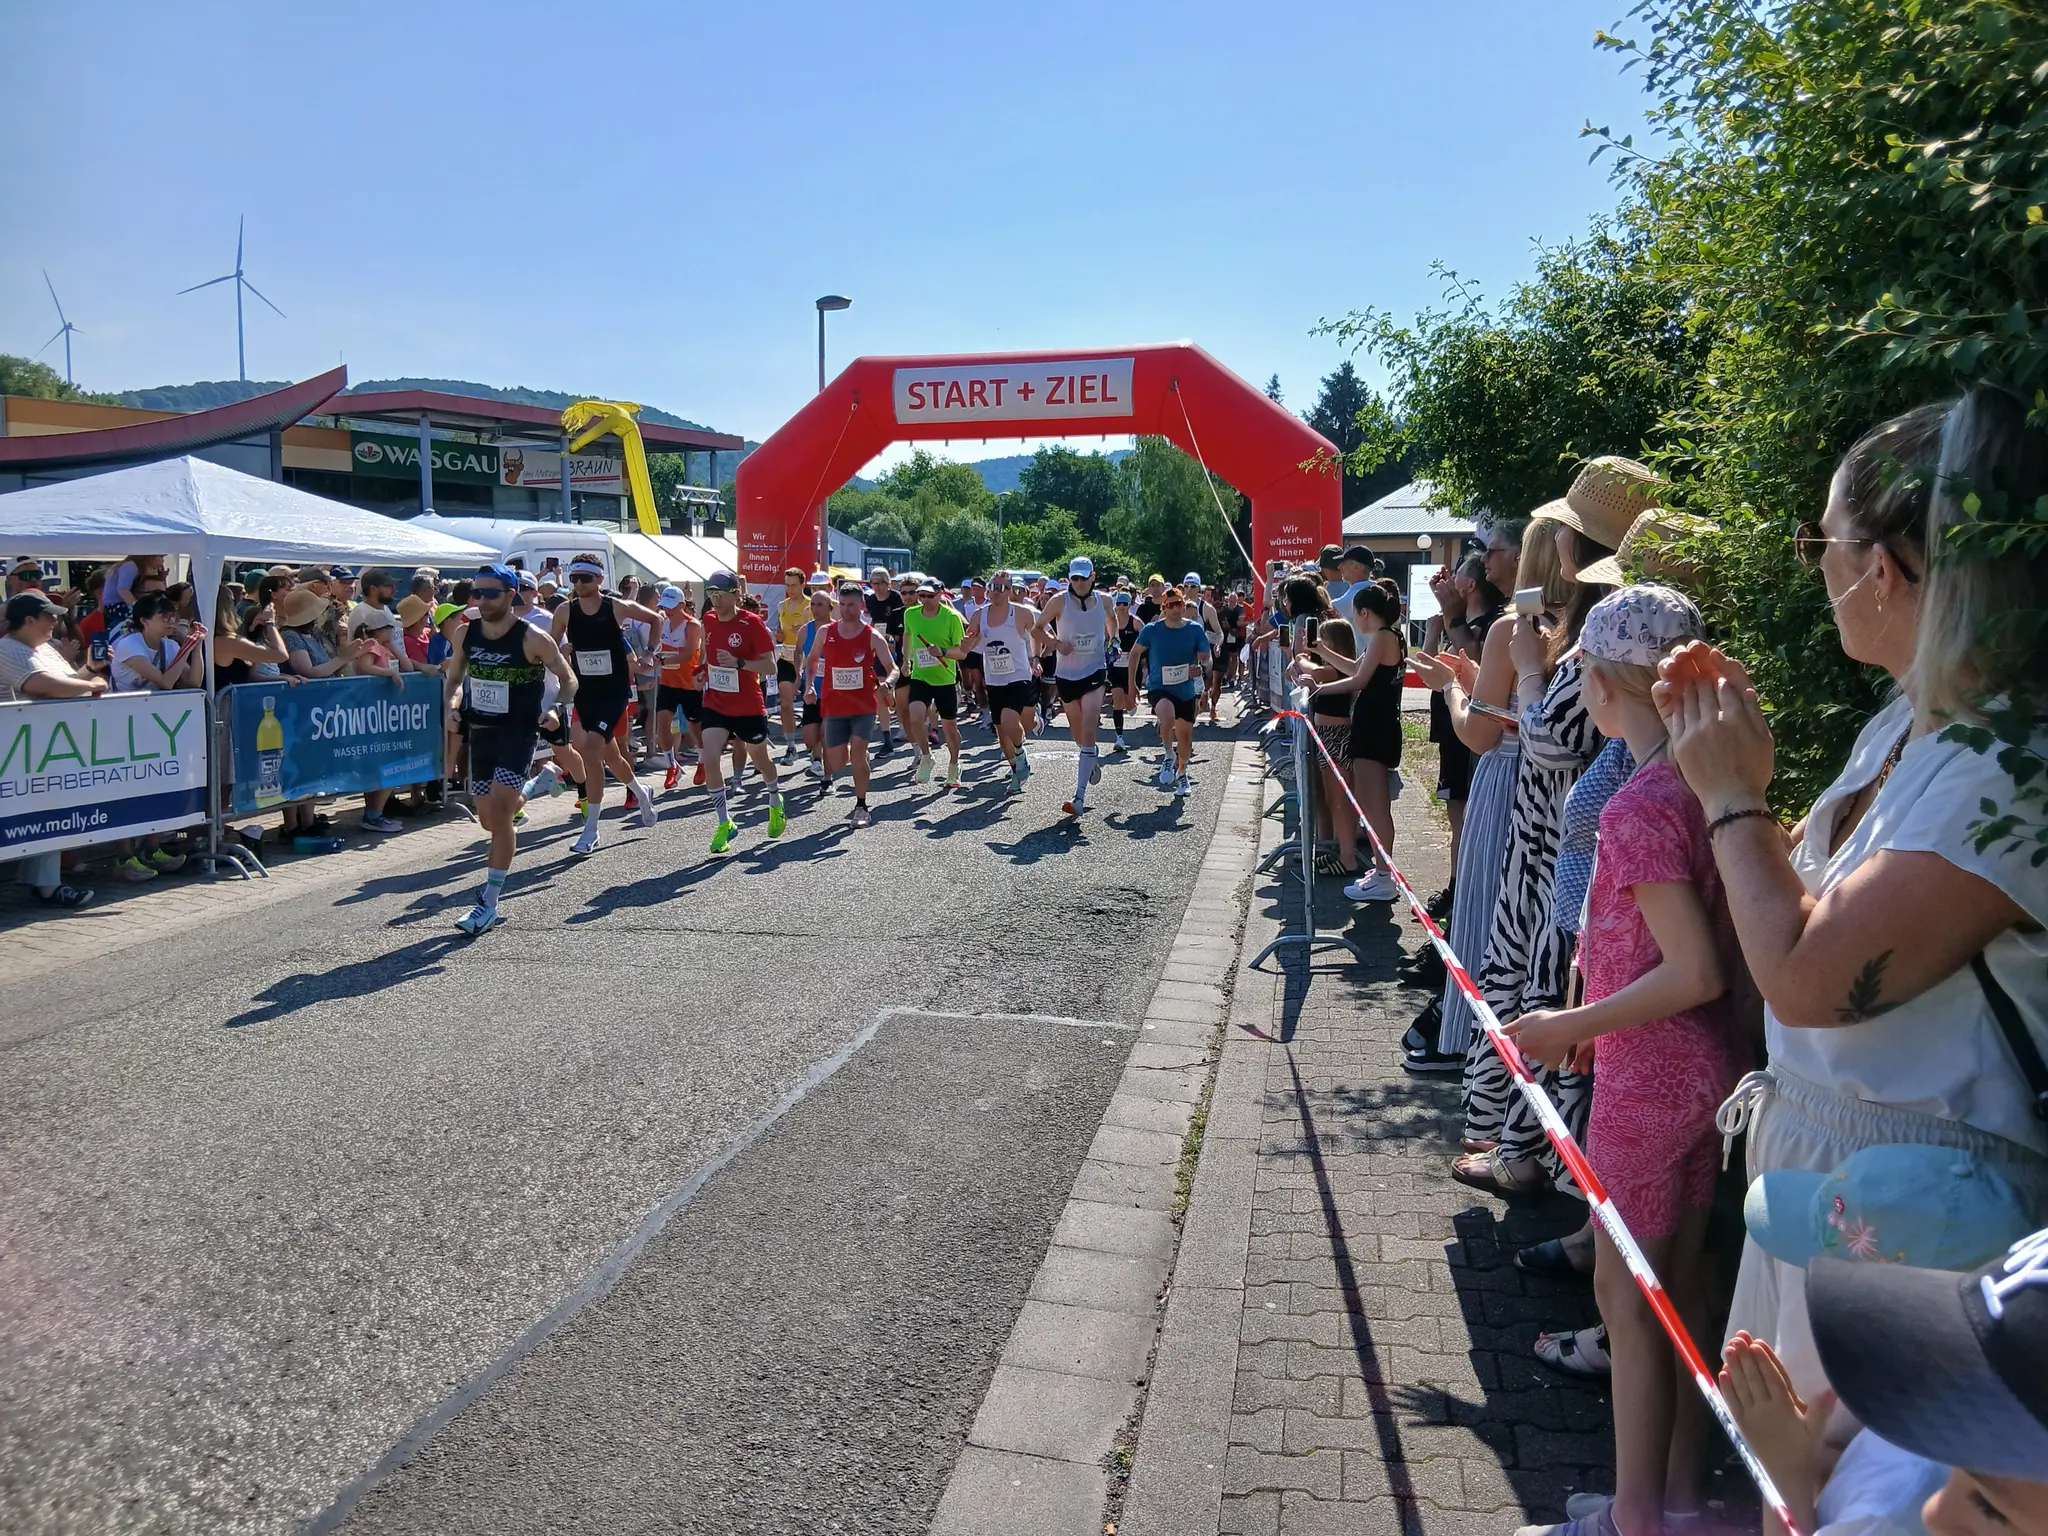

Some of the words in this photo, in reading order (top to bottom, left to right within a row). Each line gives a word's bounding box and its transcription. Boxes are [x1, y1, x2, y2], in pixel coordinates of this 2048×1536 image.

[908, 379, 1009, 410] START
[1016, 381, 1036, 401] +
[1046, 374, 1118, 405] ZIEL
[383, 445, 497, 474] WASGAU
[1282, 525, 1299, 534] Wir
[752, 532, 766, 540] Wir
[1269, 535, 1313, 546] wünschen
[749, 553, 770, 561] Ihnen
[1278, 548, 1304, 557] Ihnen
[742, 562, 753, 571] viel
[754, 563, 780, 573] Erfolg!
[585, 658, 603, 666] 1341
[713, 673, 731, 682] 1018
[476, 689, 496, 699] 1021
[310, 700, 430, 741] Schwollener
[334, 742, 369, 758] WASSER
[382, 742, 391, 752] DIE
[392, 740, 413, 751] SINNE
[5, 808, 108, 840] www.mally.de
